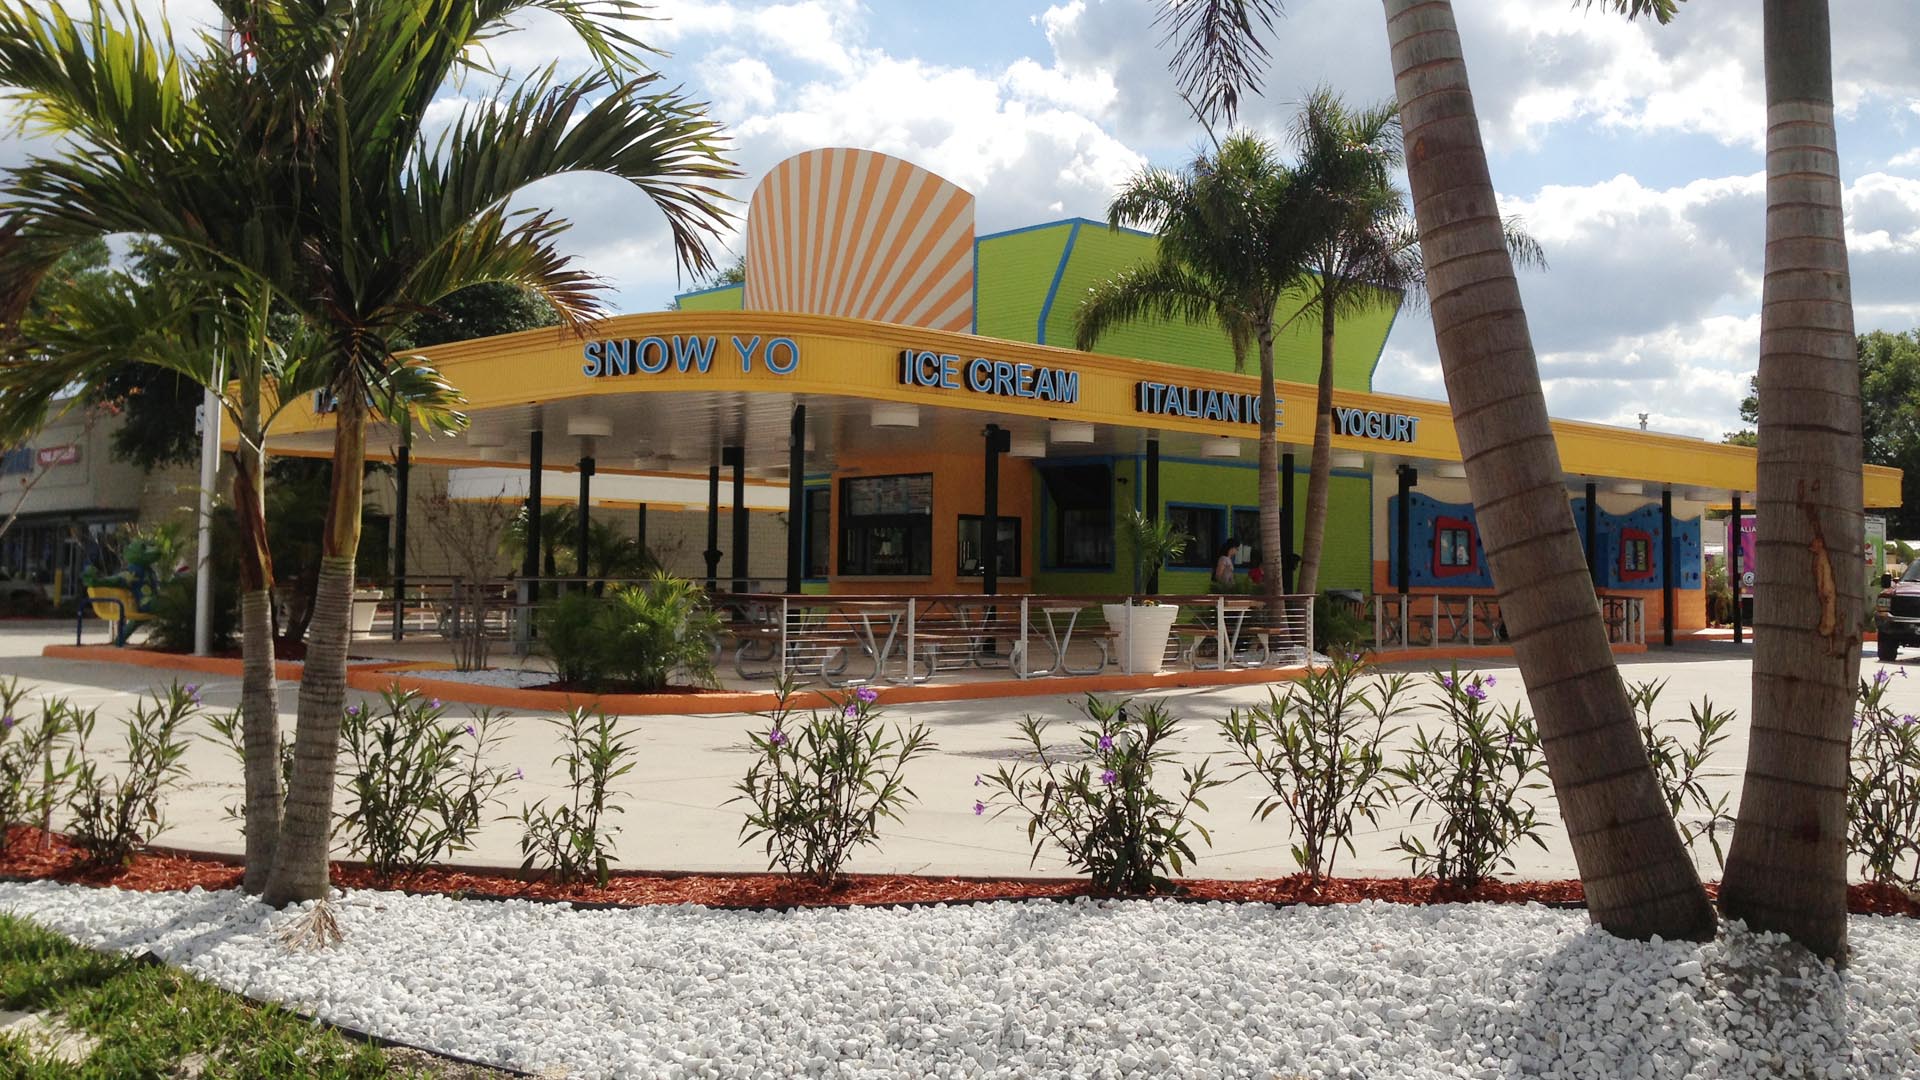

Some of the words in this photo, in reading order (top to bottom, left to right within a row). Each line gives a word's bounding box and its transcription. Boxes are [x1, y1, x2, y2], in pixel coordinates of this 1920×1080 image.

[583, 335, 717, 377] SNOW
[732, 335, 799, 374] YO
[904, 349, 960, 389] ICE
[967, 358, 1079, 403] CREAM
[1140, 381, 1239, 422] ITALIAN
[1335, 406, 1420, 442] YOGURT
